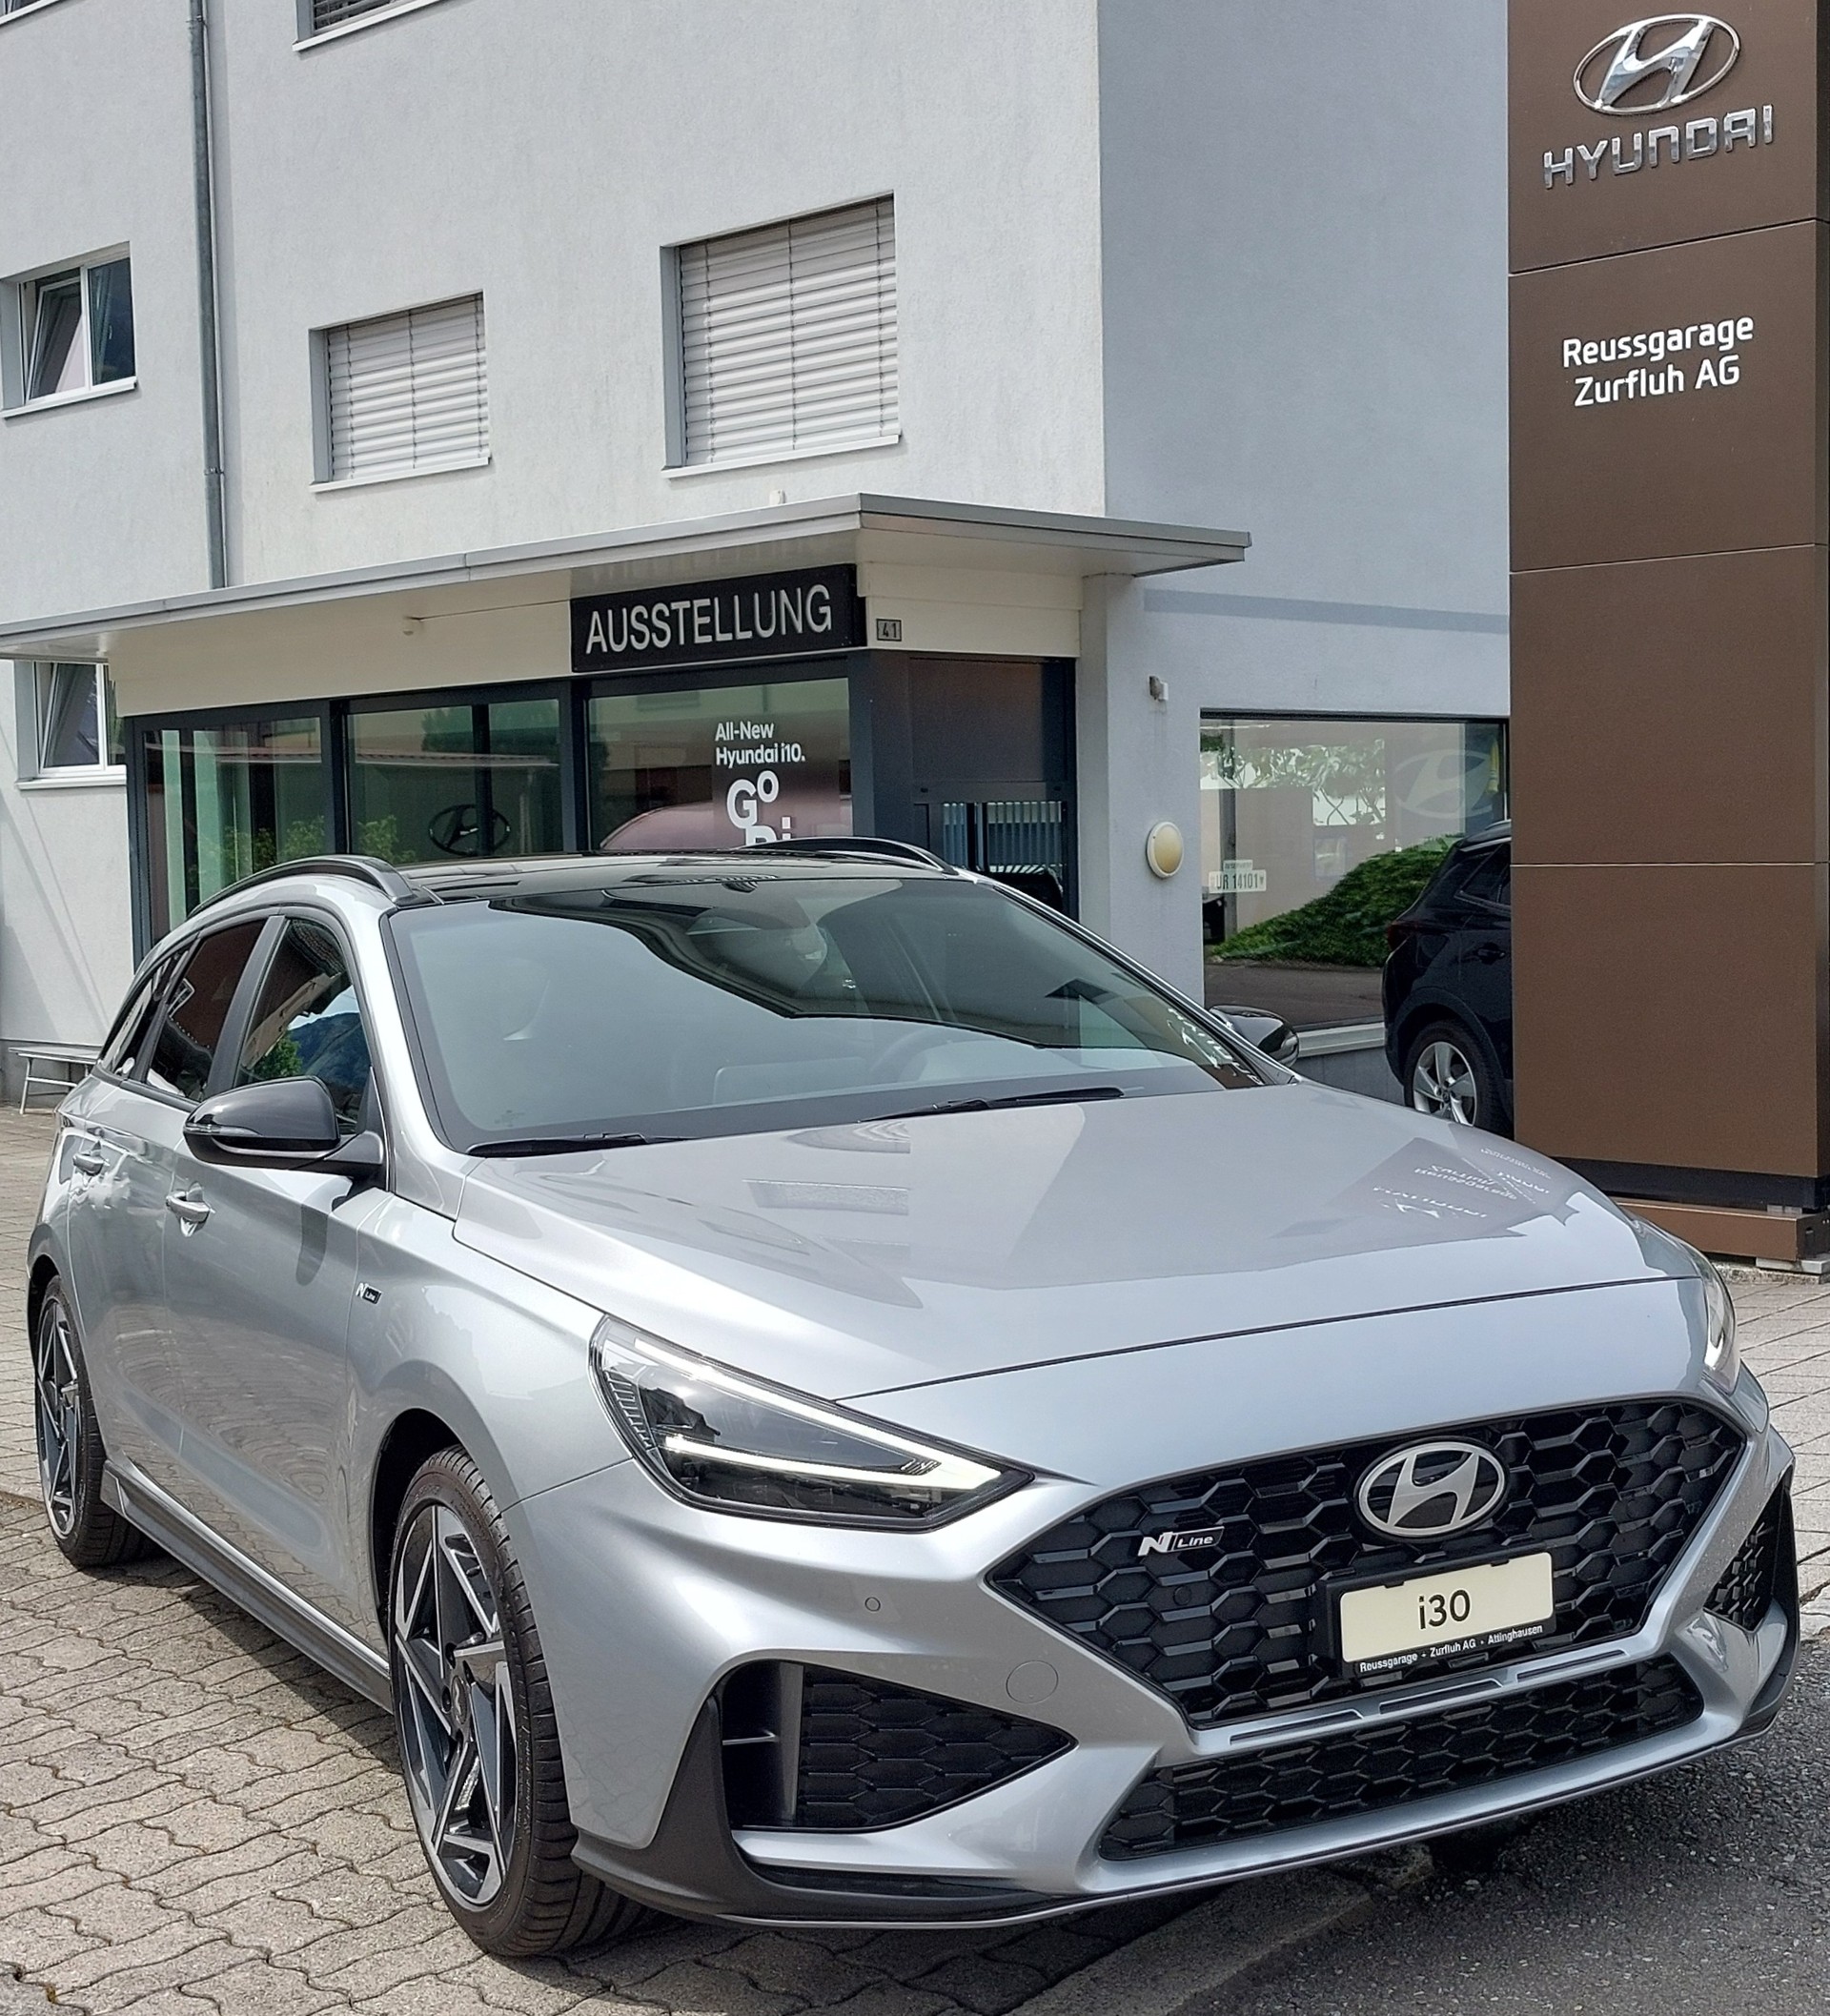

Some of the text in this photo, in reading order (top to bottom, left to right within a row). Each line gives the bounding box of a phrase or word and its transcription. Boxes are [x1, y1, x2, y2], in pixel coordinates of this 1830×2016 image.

[1543, 104, 1774, 190] HYUNDAI
[1562, 316, 1755, 368] Reussgarage
[1574, 354, 1741, 407] Zurfluh AG
[585, 583, 833, 655] AUSSTELLUNG
[883, 621, 897, 638] 41
[715, 721, 775, 742] All-New
[716, 742, 806, 769] Hyundai i10.
[1137, 1531, 1214, 1557] N Line
[1418, 1589, 1472, 1630] i30
[1359, 1624, 1543, 1673] Reussgarage Zurfluh AG Attinghausen
